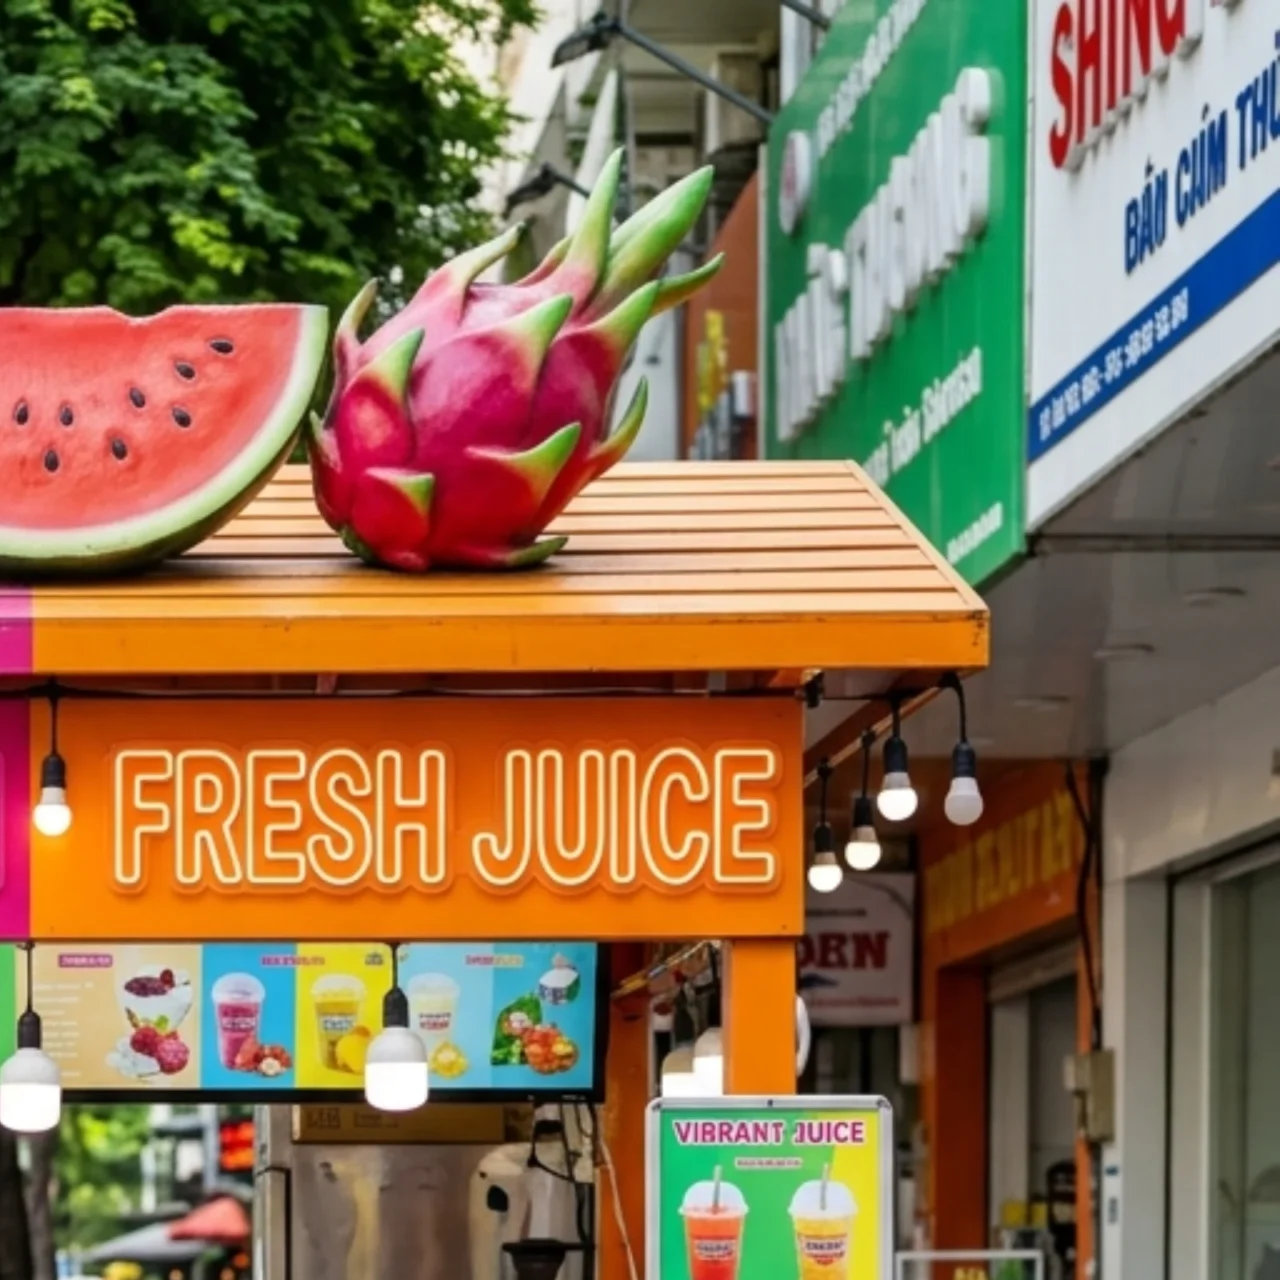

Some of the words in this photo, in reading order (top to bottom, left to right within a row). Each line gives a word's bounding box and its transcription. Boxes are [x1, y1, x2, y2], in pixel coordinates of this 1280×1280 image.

[113, 746, 447, 887] FRESH
[471, 746, 777, 887] JUICE
[673, 1120, 785, 1144] VIBRANT
[794, 1120, 865, 1144] JUICE
